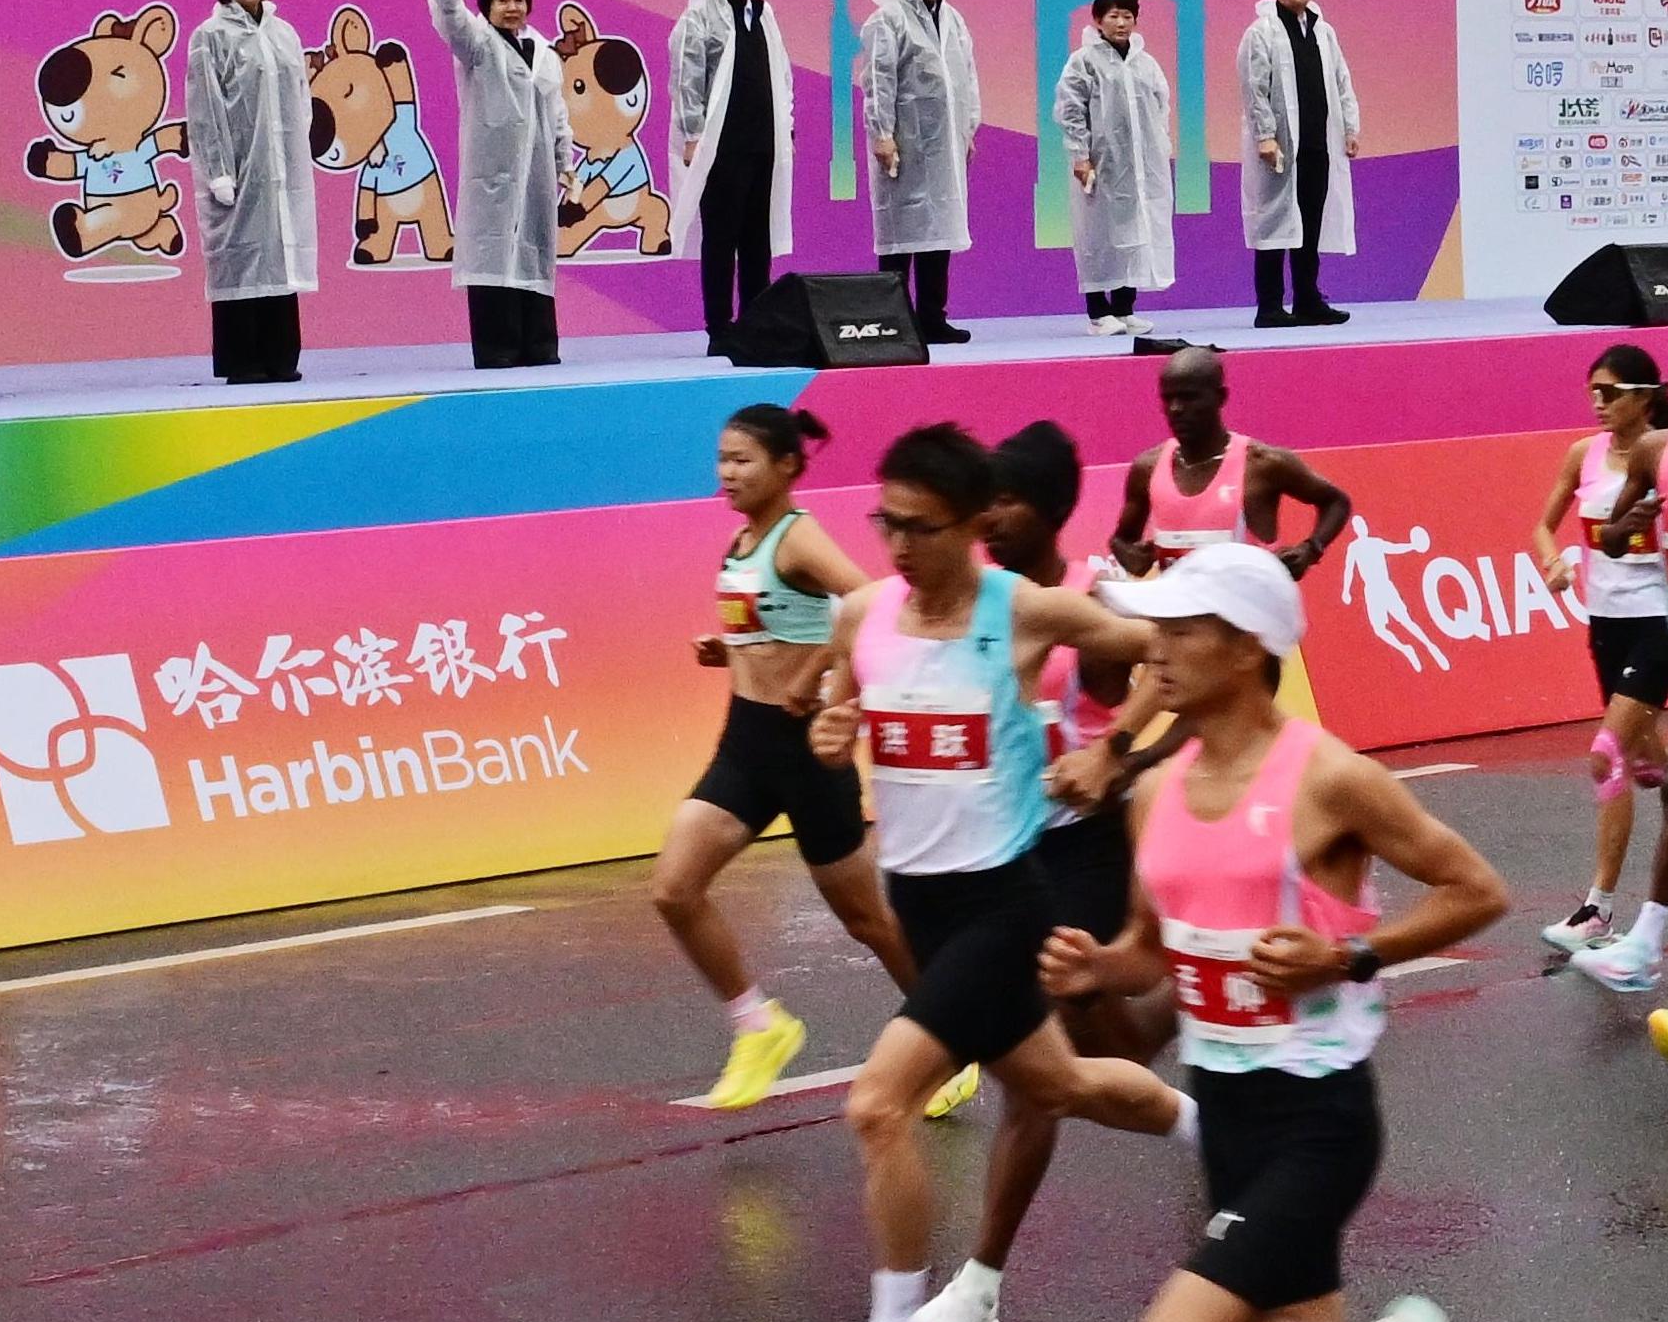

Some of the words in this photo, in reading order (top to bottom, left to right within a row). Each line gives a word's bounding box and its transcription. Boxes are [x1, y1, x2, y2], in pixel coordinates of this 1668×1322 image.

[154, 611, 569, 730] 哈尔滨银行
[188, 716, 591, 822] HarbinBank
